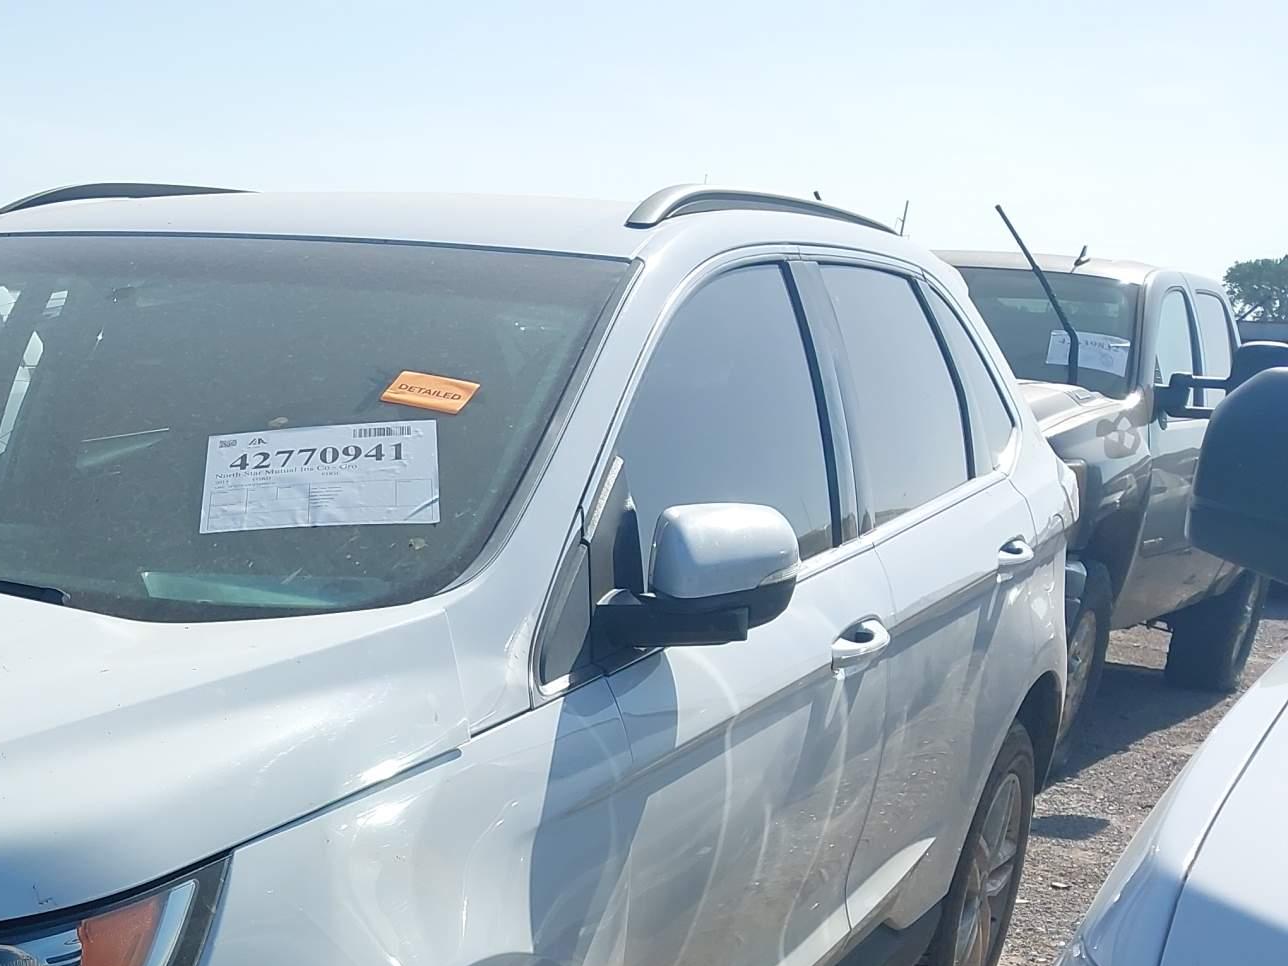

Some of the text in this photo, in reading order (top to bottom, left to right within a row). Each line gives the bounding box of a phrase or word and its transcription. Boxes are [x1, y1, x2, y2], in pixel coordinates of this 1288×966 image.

[398, 383, 462, 401] DETAILED
[229, 442, 406, 471] 42770941
[215, 471, 241, 479] North
[265, 467, 297, 475] Mutual
